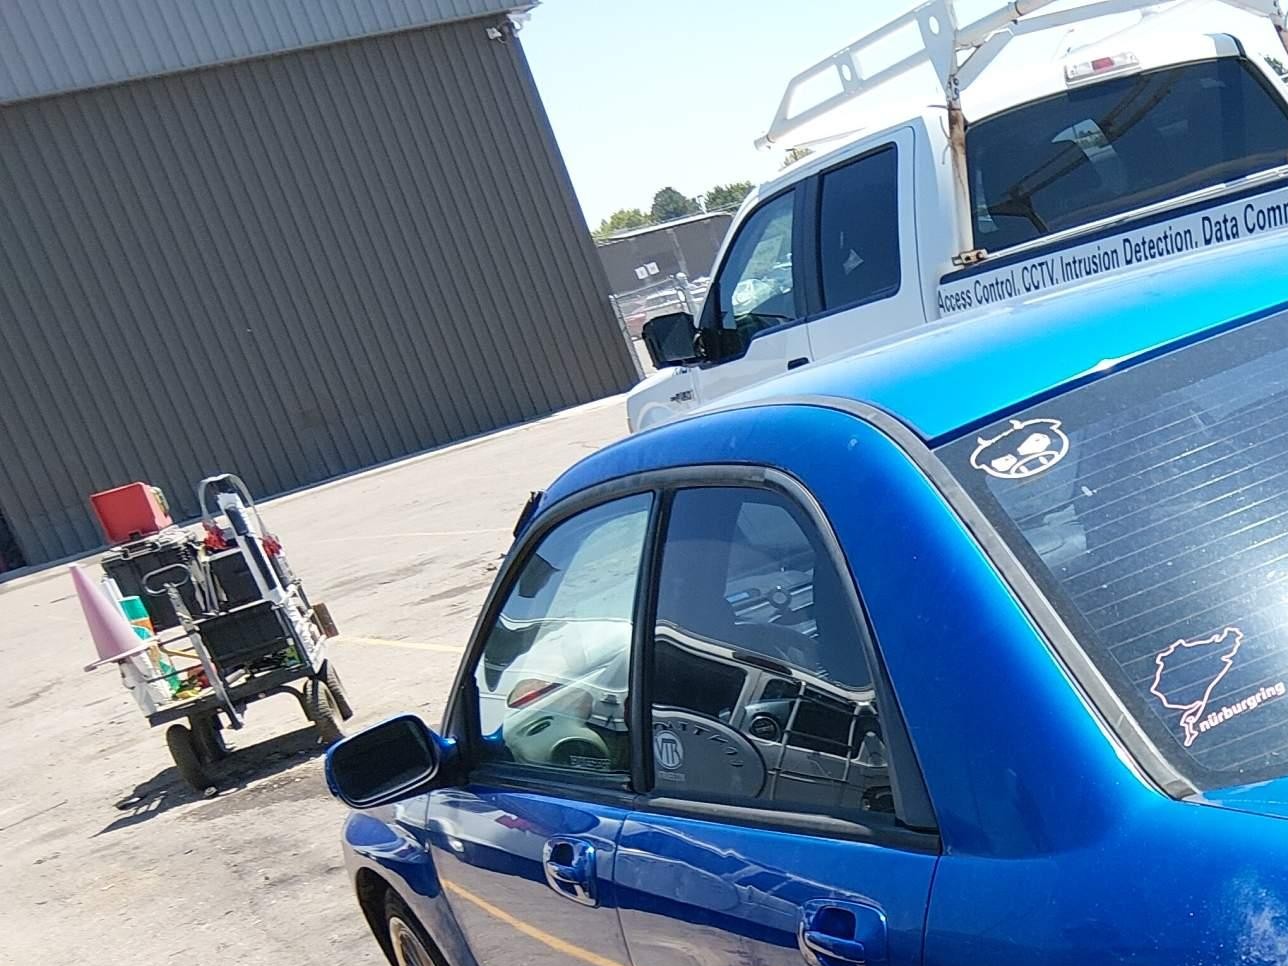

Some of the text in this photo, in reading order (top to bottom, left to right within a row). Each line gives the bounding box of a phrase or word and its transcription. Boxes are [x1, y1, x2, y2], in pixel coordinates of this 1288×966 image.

[937, 289, 973, 313] Access
[1060, 246, 1121, 283] Intrusion
[1201, 213, 1240, 246] Data
[1198, 681, 1286, 733] nürburgring
